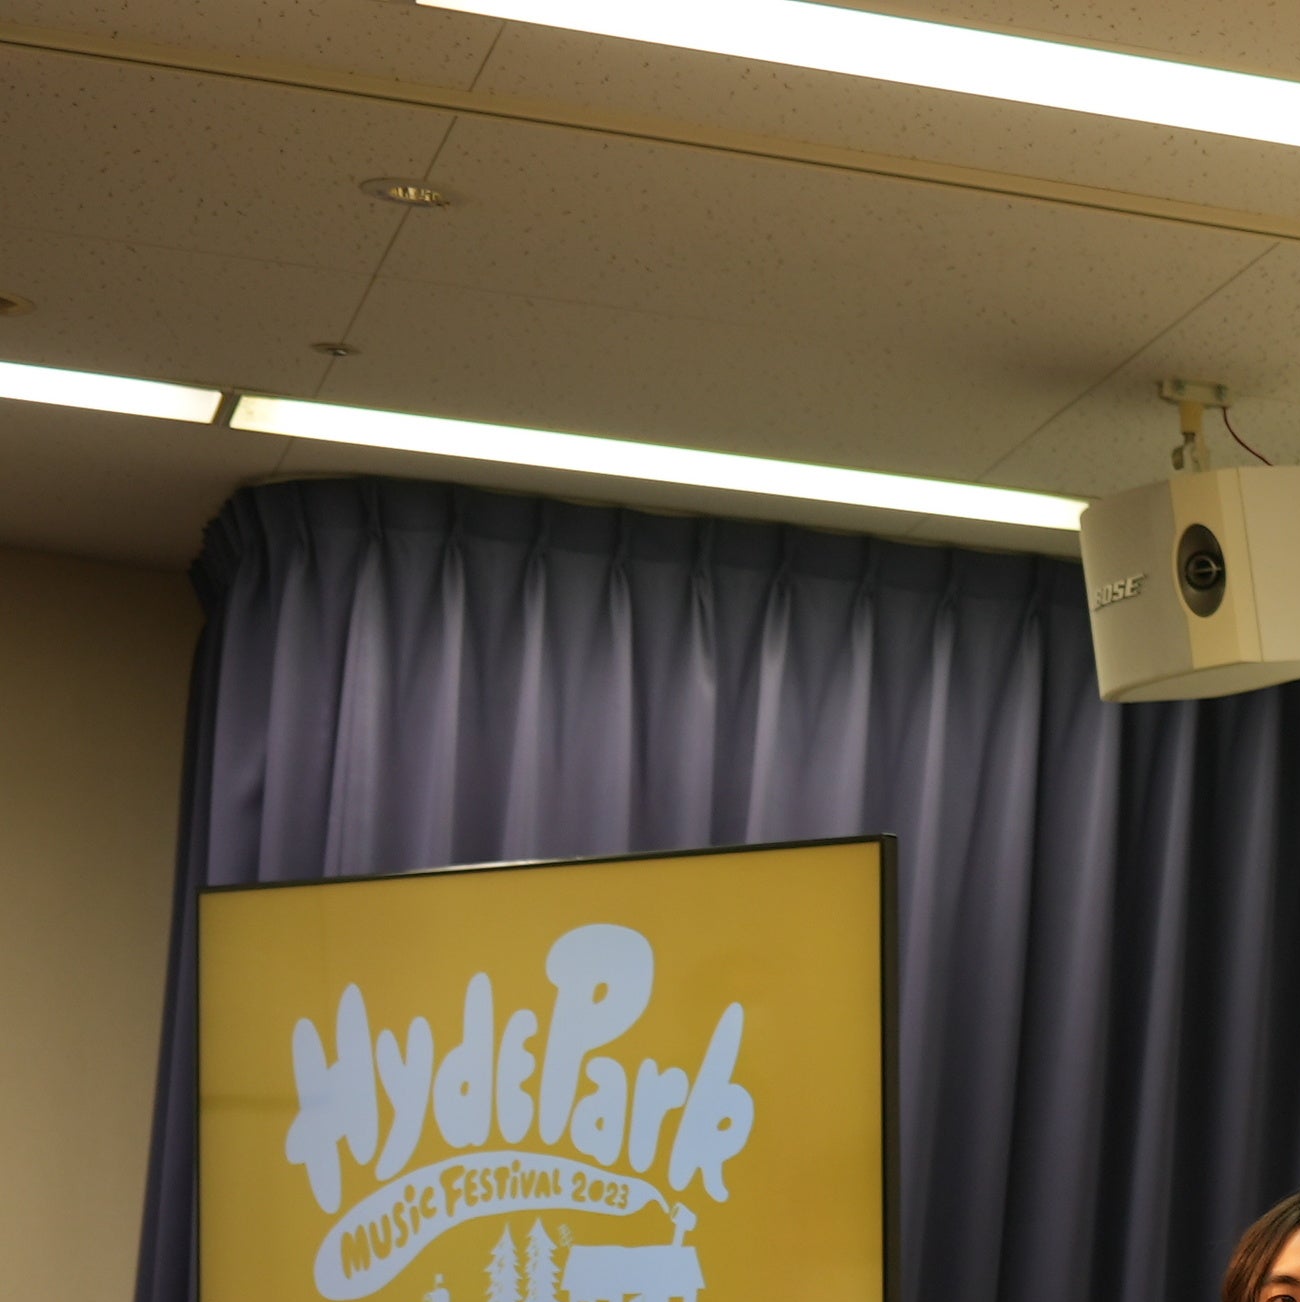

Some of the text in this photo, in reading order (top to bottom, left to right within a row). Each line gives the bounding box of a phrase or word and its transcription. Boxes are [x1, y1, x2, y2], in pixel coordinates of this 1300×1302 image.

[285, 923, 755, 1215] Hyde Park
[571, 1171, 630, 1210] 2023
